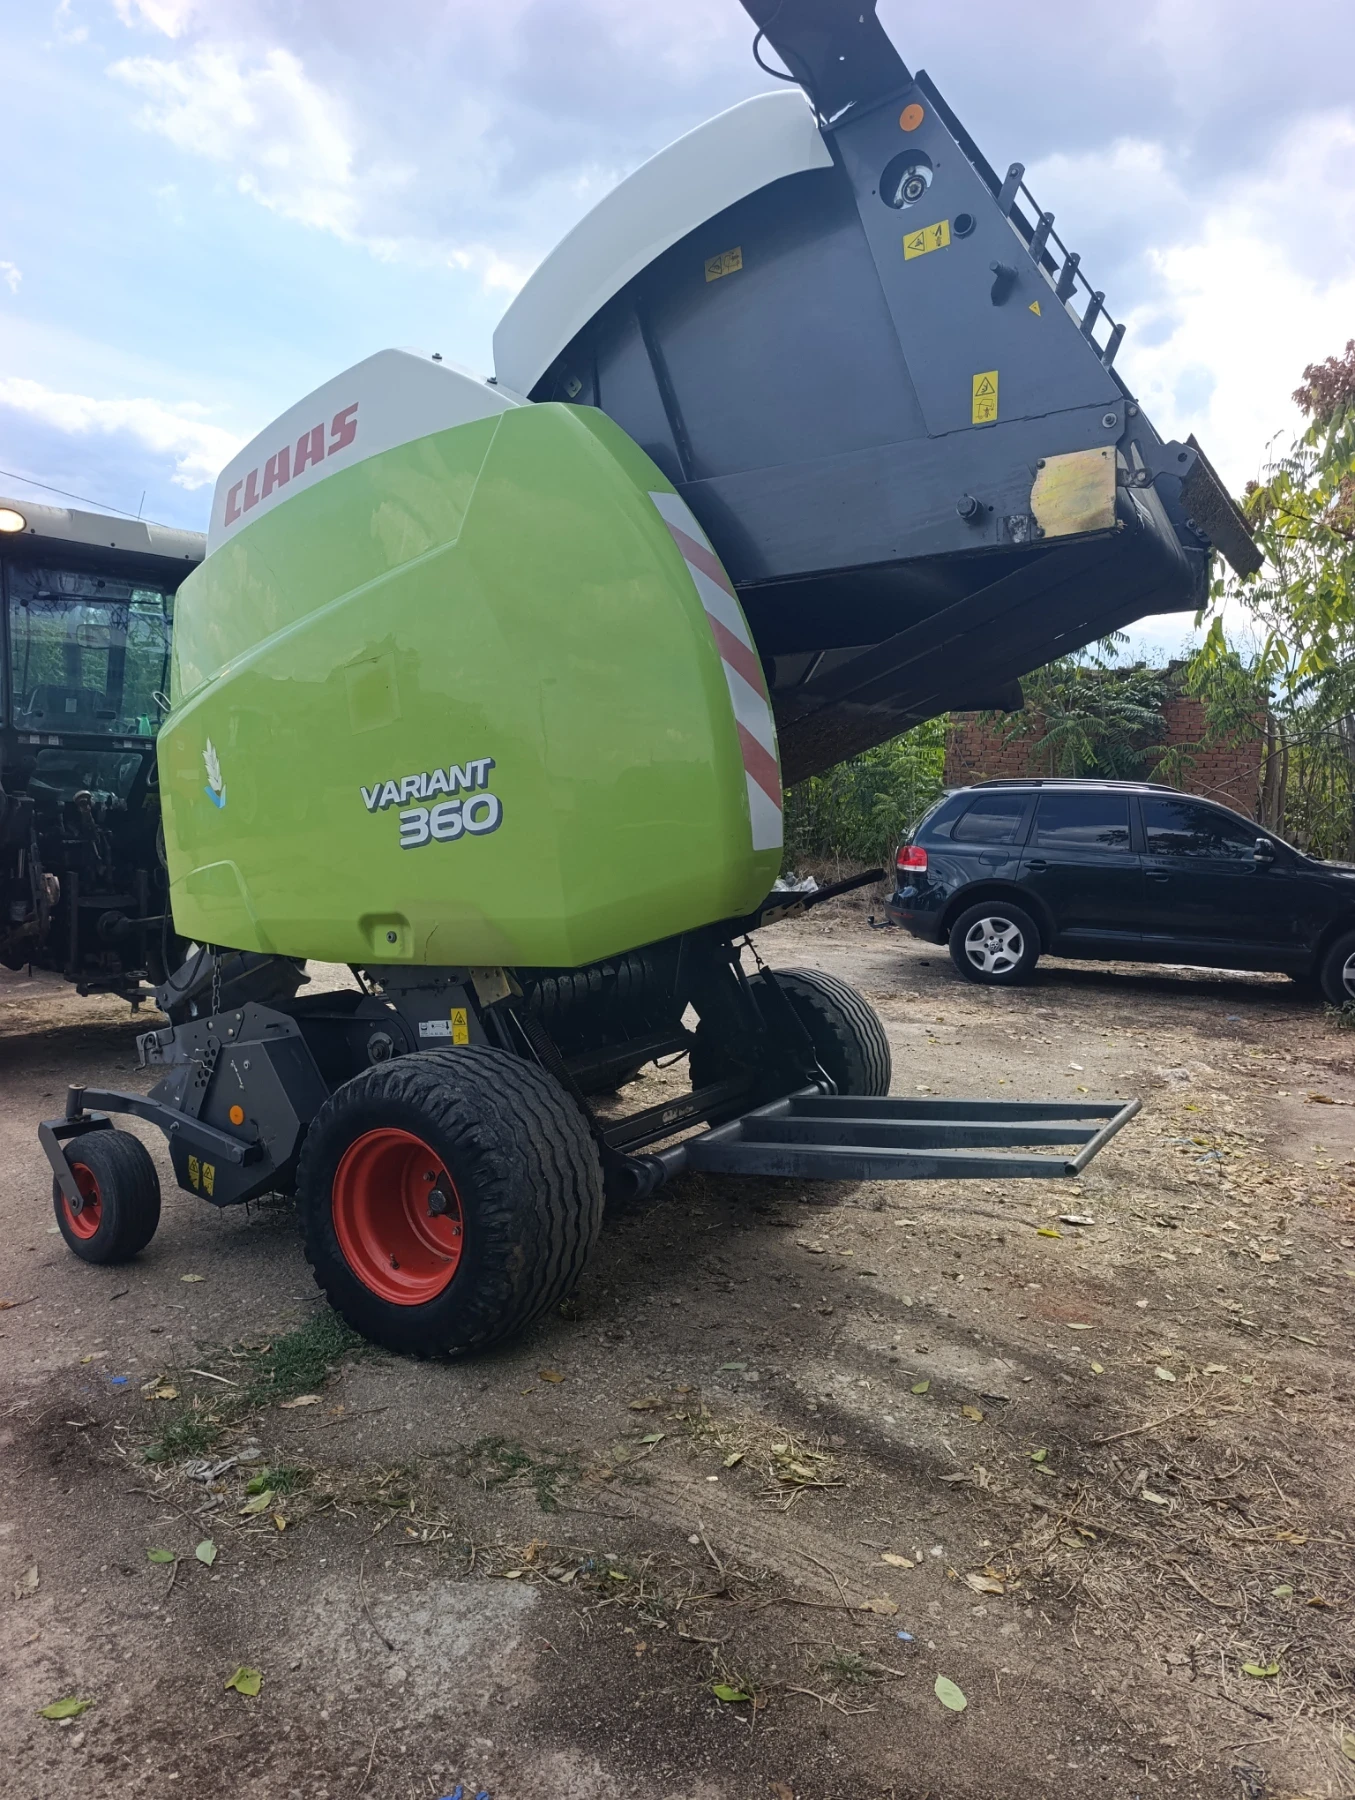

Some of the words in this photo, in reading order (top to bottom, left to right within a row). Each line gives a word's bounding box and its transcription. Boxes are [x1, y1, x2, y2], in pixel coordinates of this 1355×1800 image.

[224, 401, 359, 528] CLAAS
[360, 756, 496, 814] VARIANT
[399, 793, 504, 850] 360
